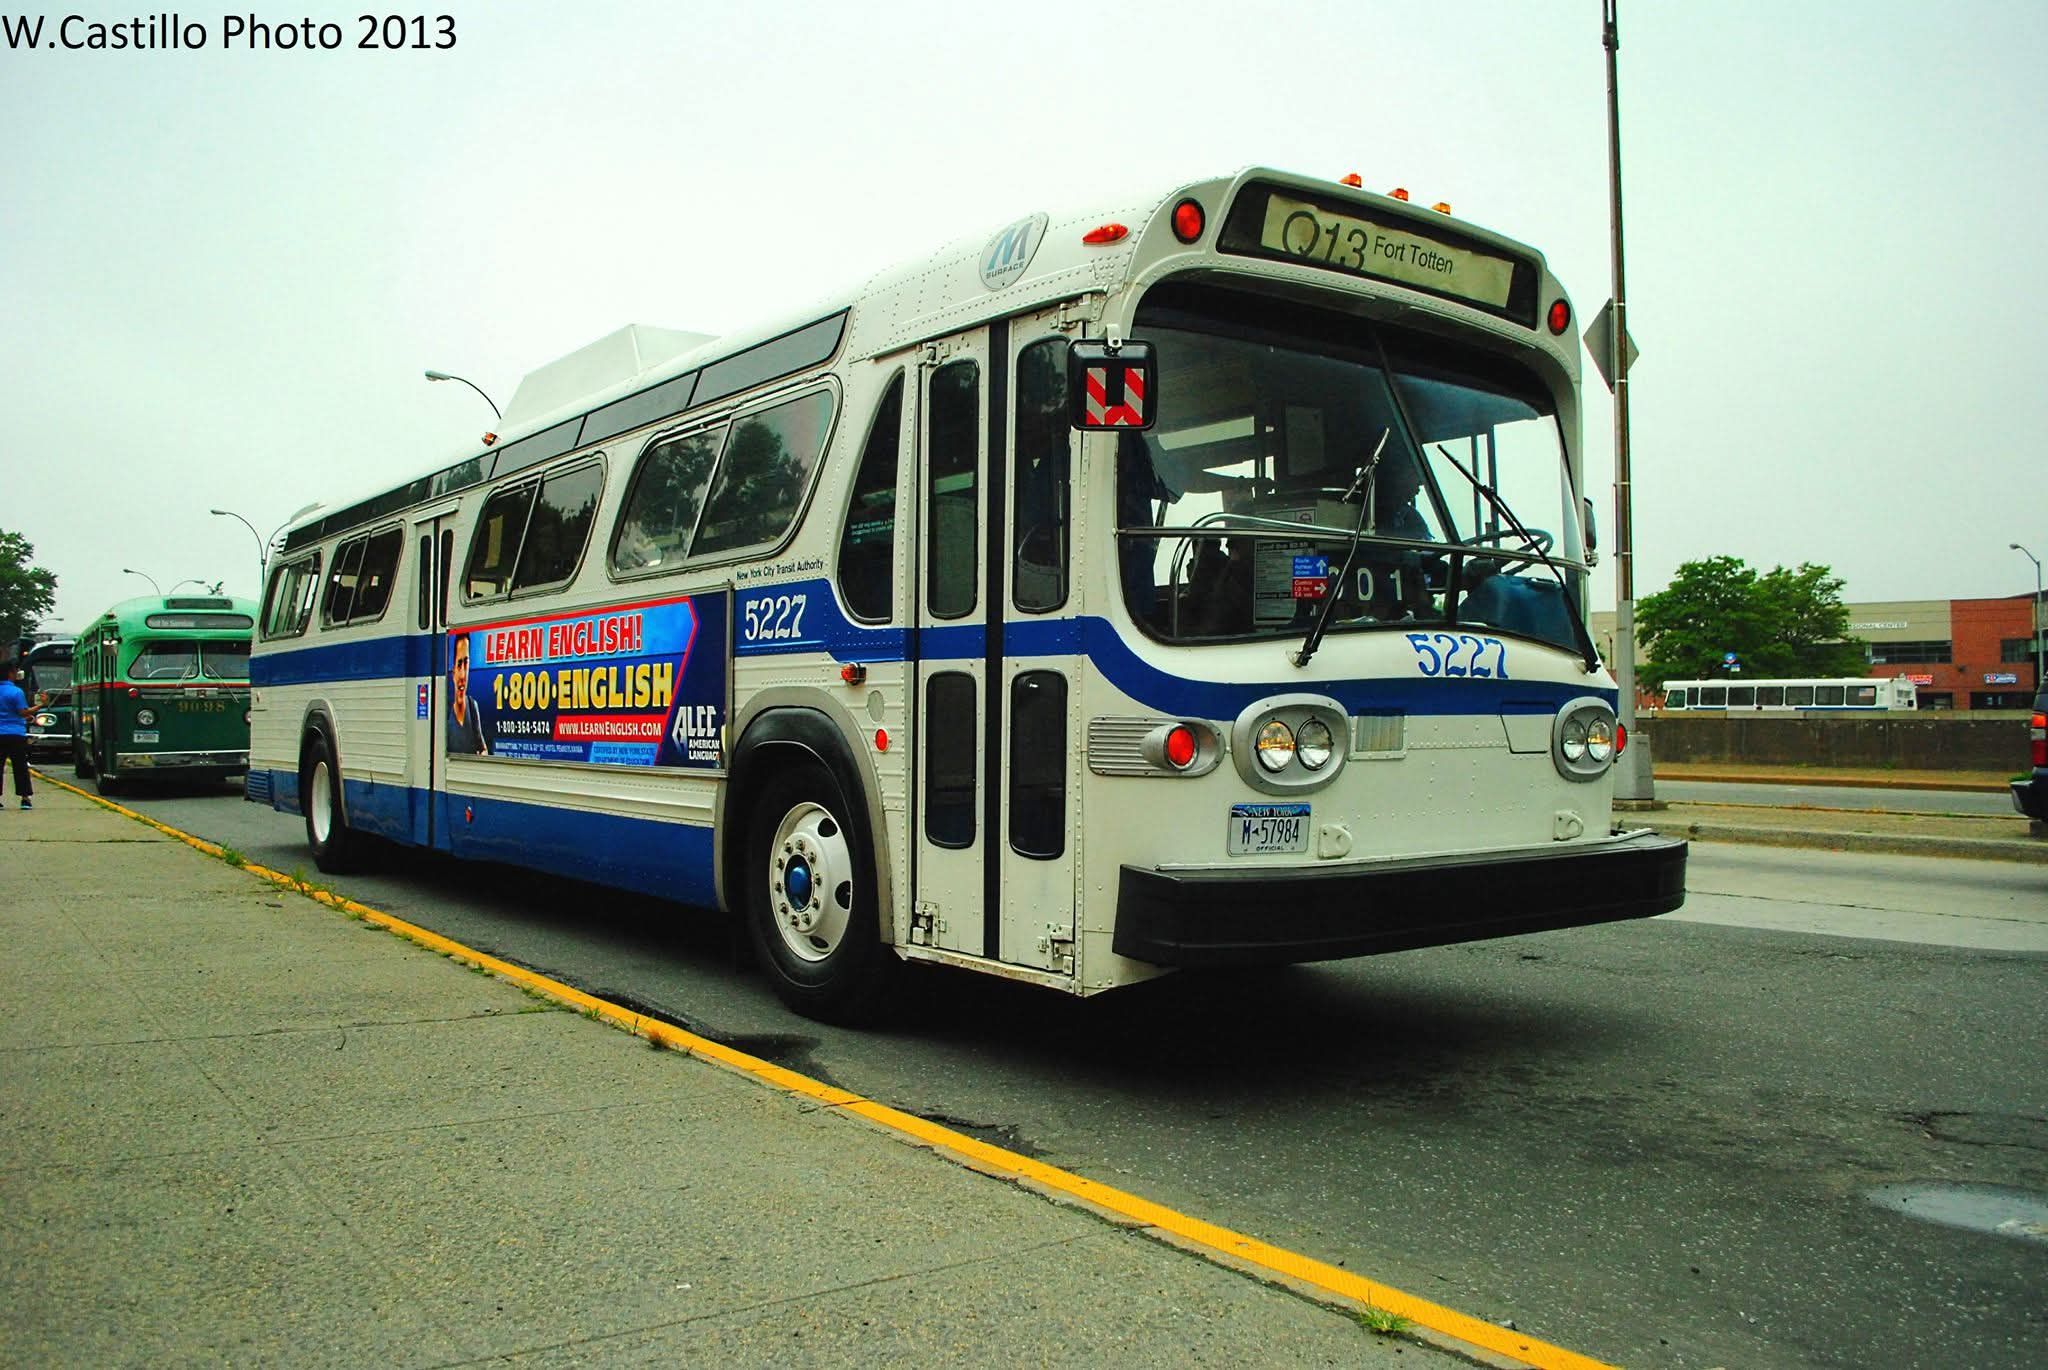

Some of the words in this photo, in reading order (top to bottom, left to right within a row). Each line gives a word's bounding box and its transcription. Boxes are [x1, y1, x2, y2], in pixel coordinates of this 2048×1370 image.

[1282, 210, 1368, 271] Q13
[1374, 235, 1405, 262] Fort
[1410, 244, 1453, 274] Totten
[985, 261, 1024, 279] SURFACE
[737, 570, 748, 580] New
[750, 567, 762, 578] York
[764, 565, 775, 577] City
[776, 562, 796, 575] Transit
[797, 559, 824, 571] Authority
[745, 594, 806, 640] 5227
[486, 628, 544, 663] LEARN
[548, 613, 642, 657] ENGLISH!
[1406, 634, 1508, 679] 5227
[688, 739, 720, 749] AMERICAN
[1251, 808, 1270, 816] NEW
[1273, 807, 1293, 816] YORK
[1242, 819, 1251, 844] M
[1260, 818, 1300, 844] 57984
